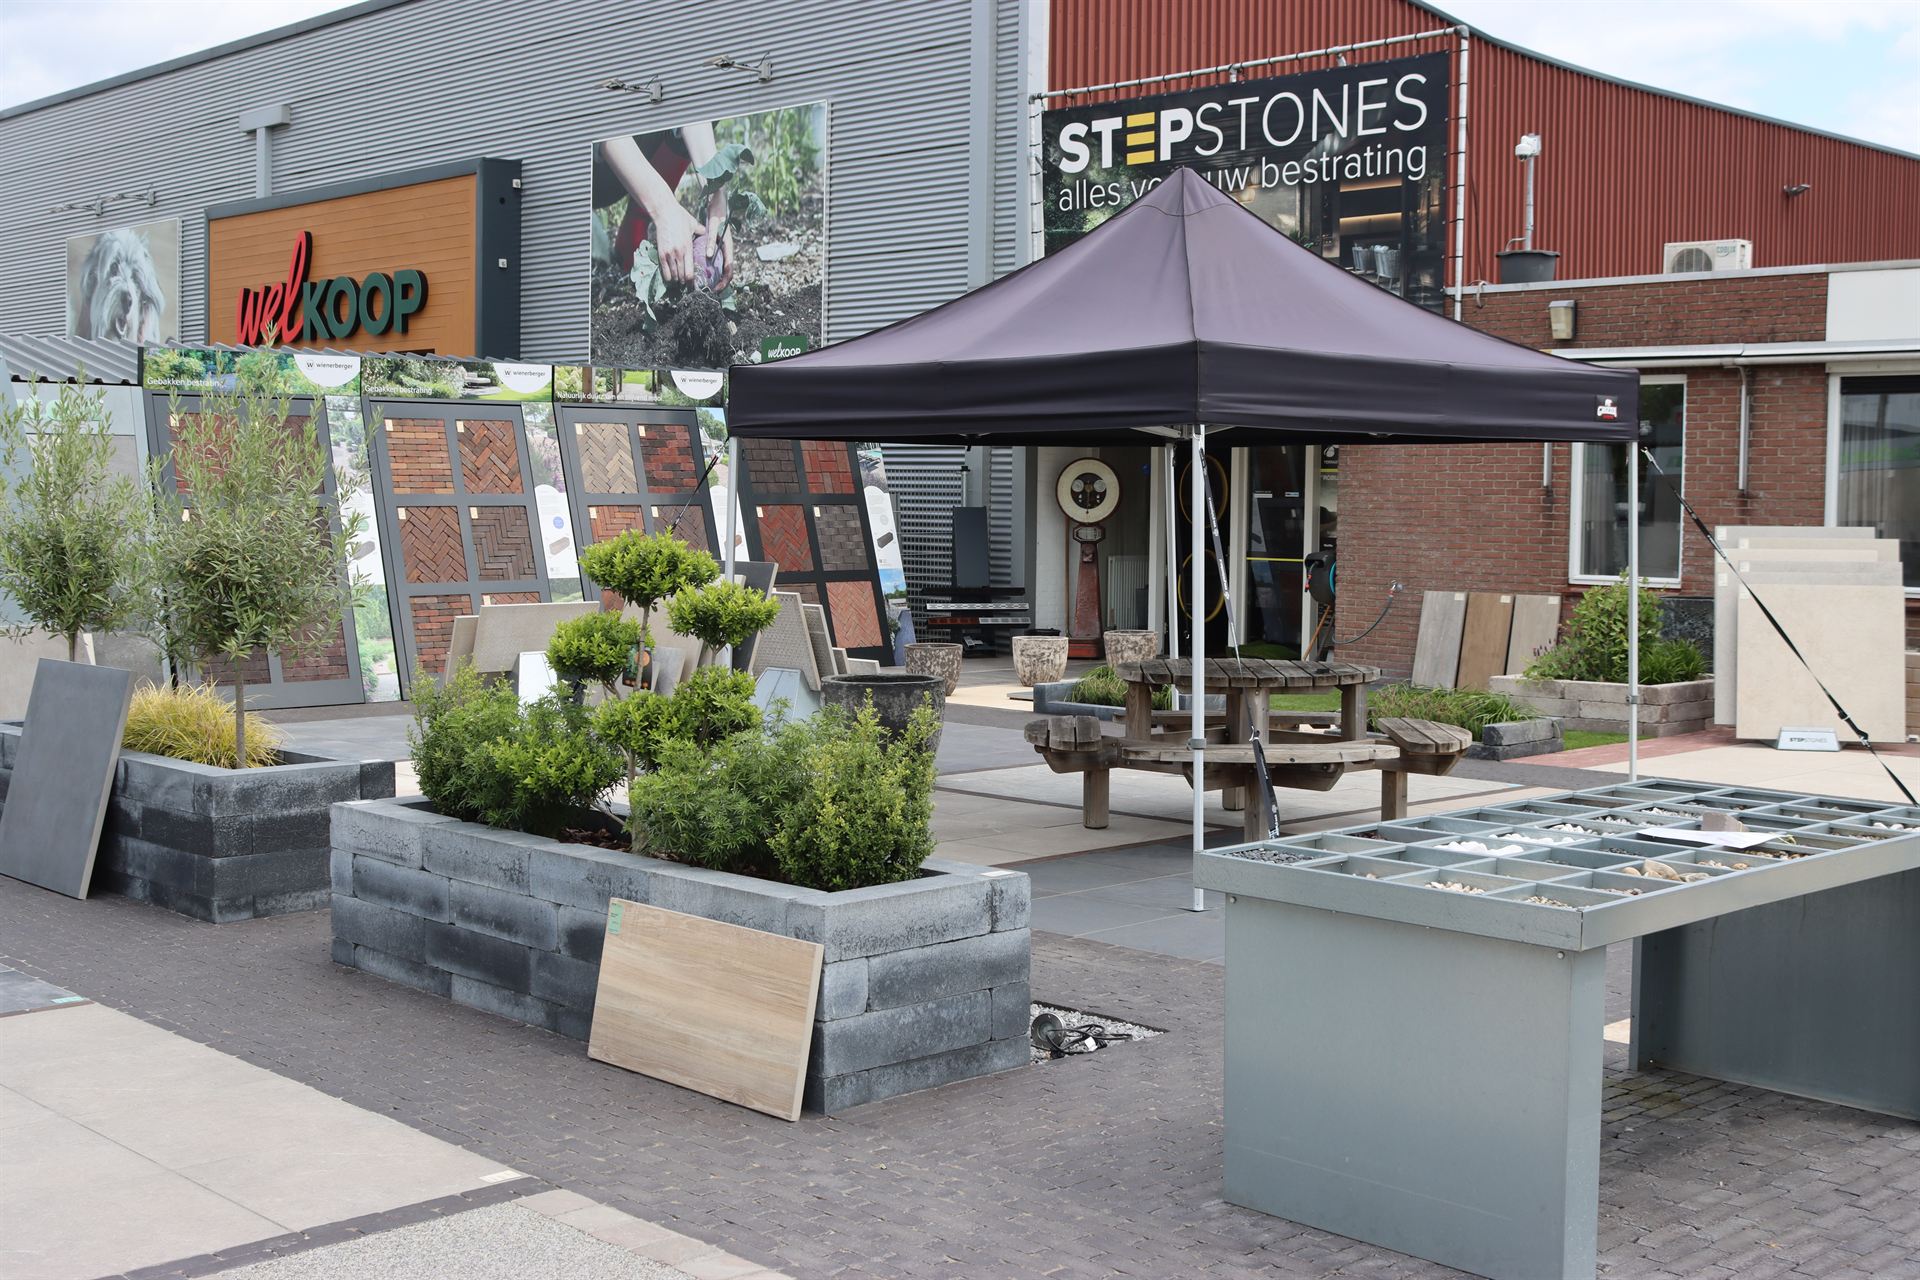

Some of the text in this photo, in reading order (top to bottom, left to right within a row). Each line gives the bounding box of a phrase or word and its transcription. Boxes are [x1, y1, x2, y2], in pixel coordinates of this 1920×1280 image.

[1059, 73, 1427, 174] STEPSTONES
[1059, 179, 1121, 212] alles
[1261, 144, 1427, 188] bestrating
[316, 362, 353, 370] wienerberger
[513, 370, 546, 378] wienerberger
[147, 376, 186, 386] Gebakken
[364, 384, 433, 396] Gebakken bestrating
